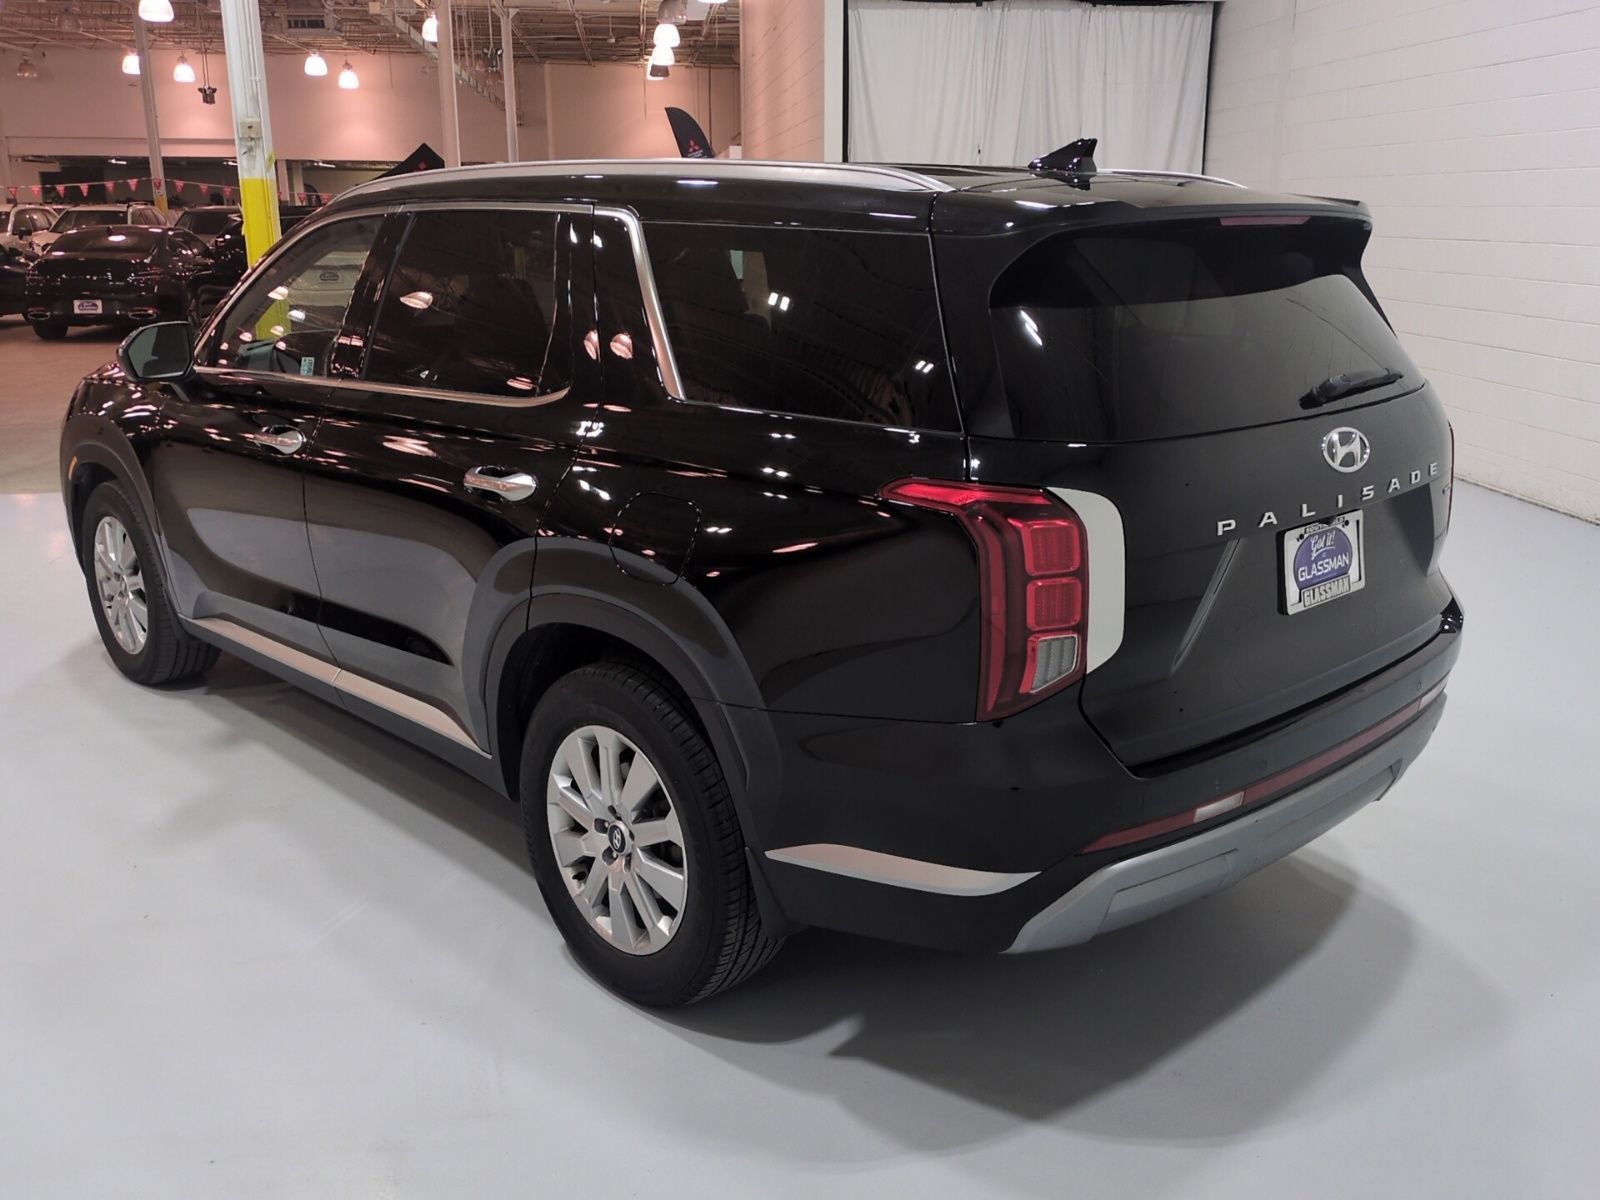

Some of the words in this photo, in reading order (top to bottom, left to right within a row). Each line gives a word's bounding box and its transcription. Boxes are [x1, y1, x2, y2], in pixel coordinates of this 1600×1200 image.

[1216, 462, 1438, 536] PALISADE
[1298, 552, 1350, 582] GLASSMAN
[1304, 576, 1350, 606] GLASSMAN
